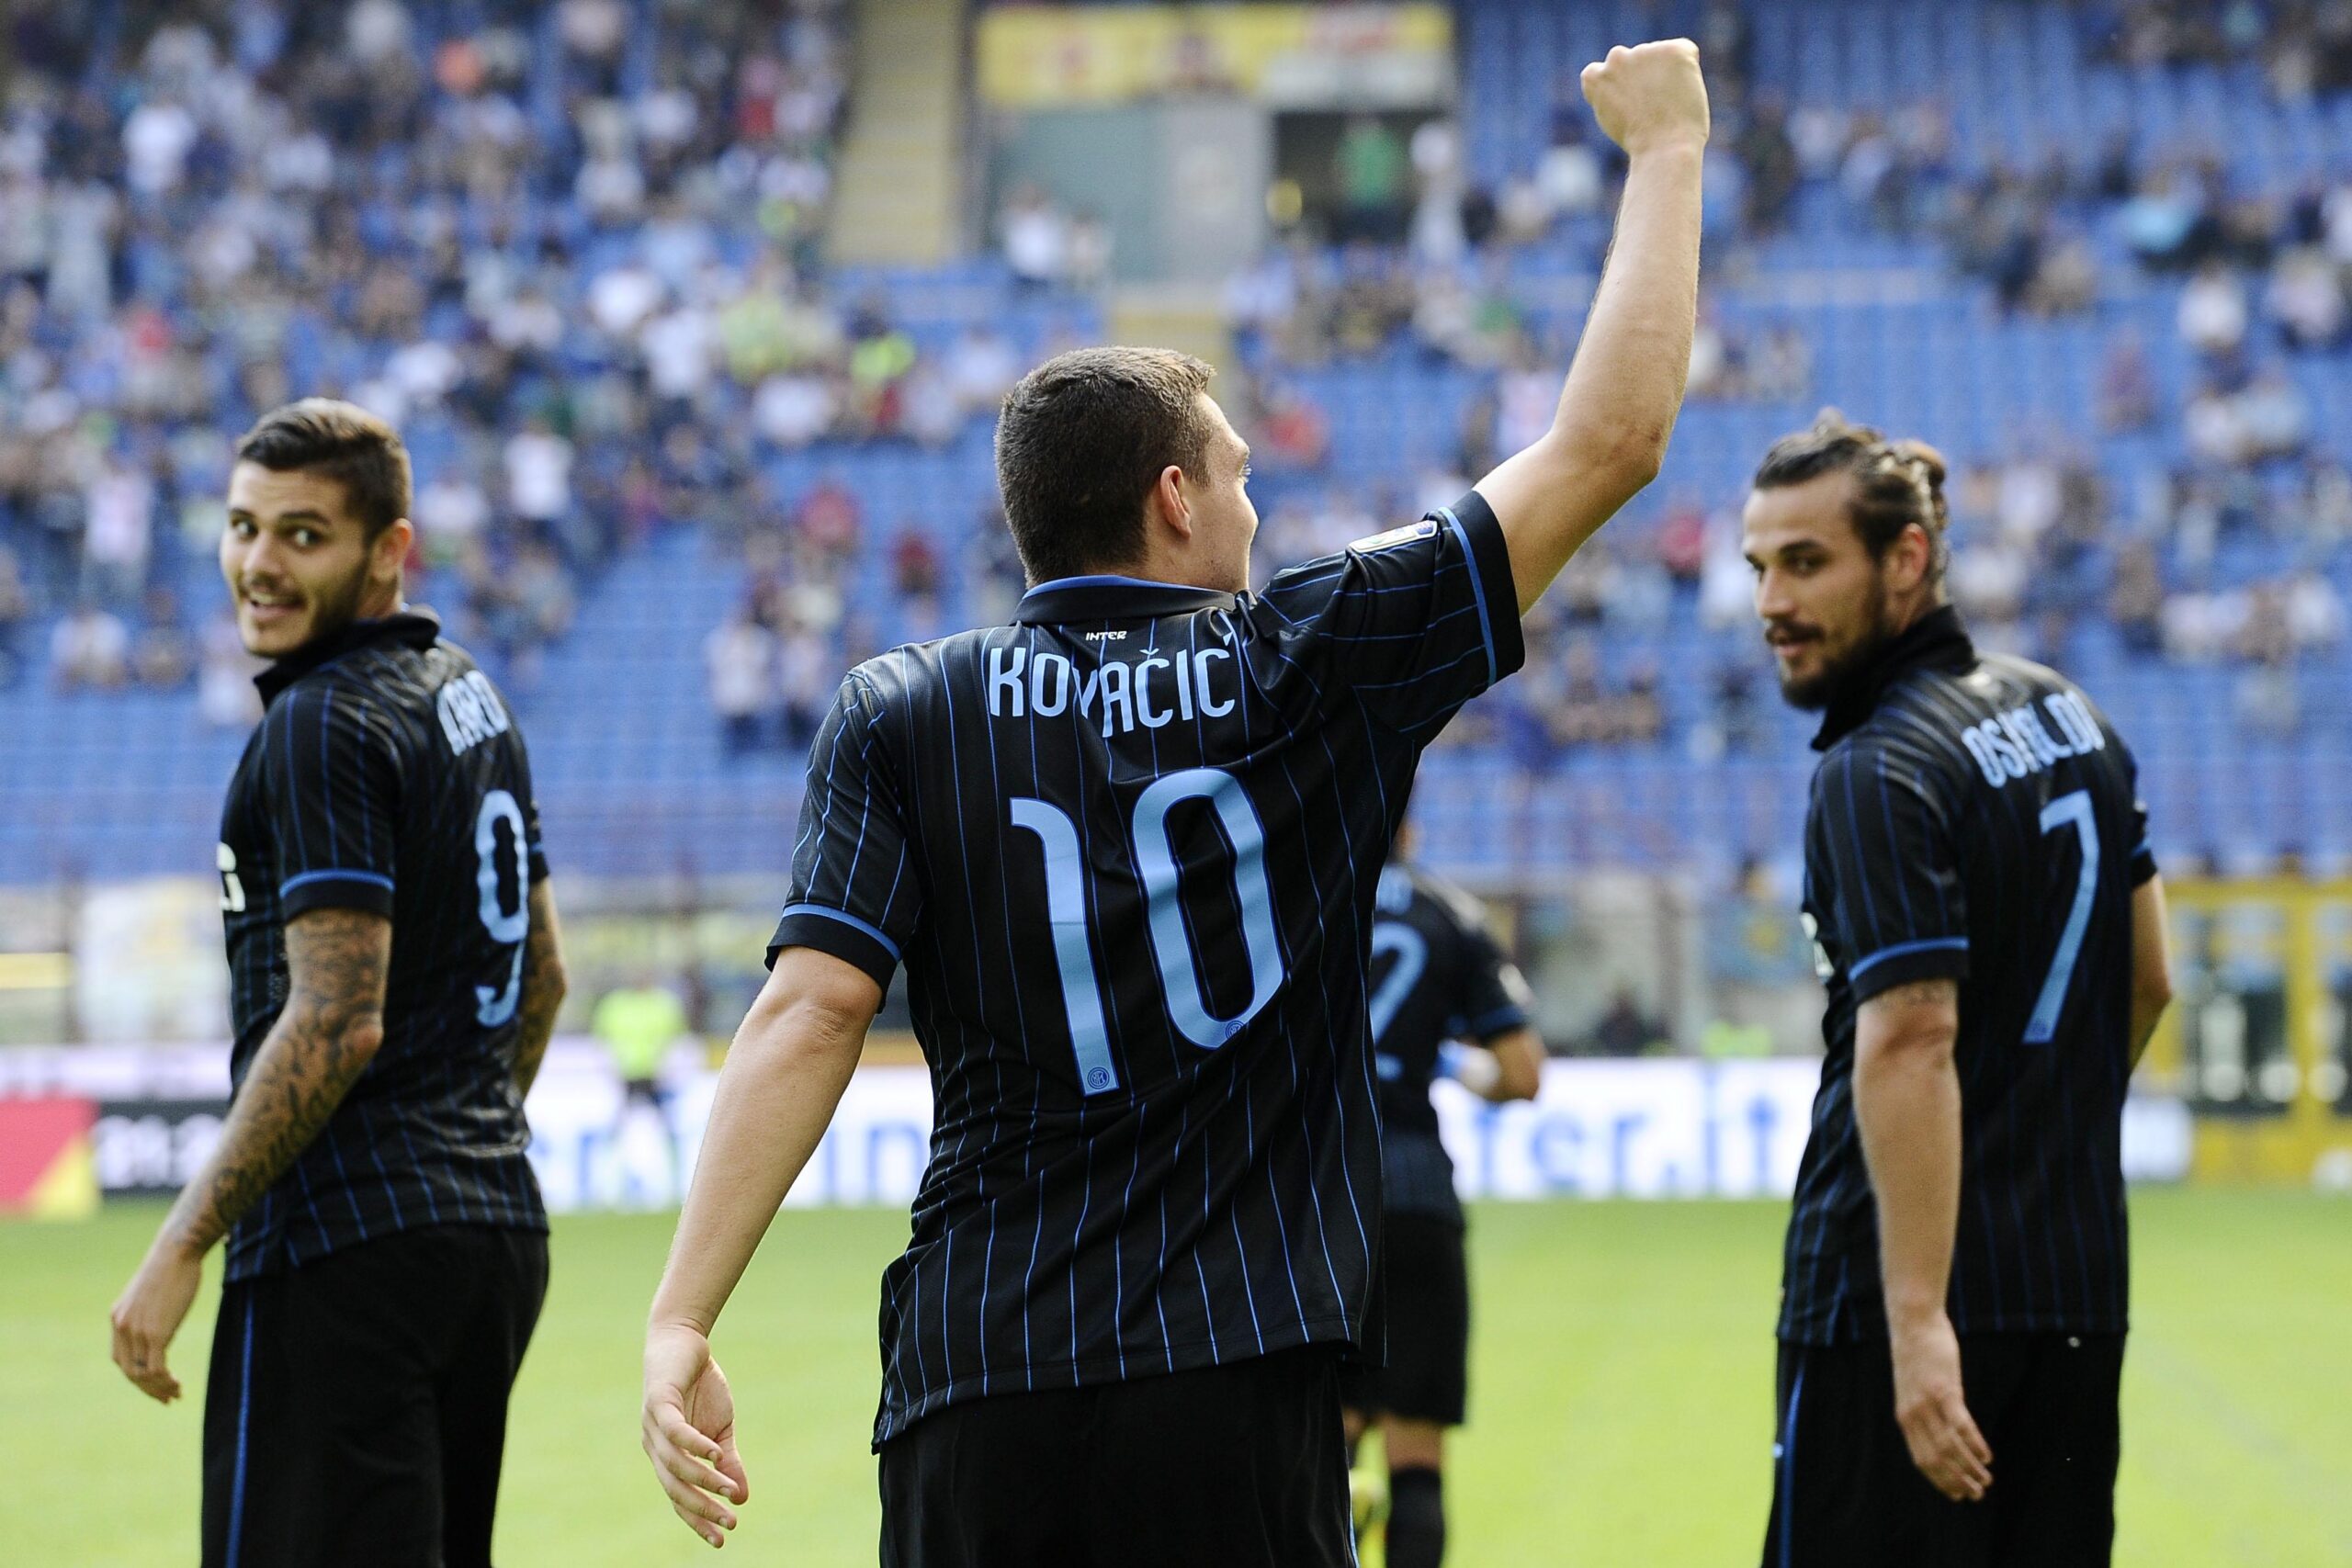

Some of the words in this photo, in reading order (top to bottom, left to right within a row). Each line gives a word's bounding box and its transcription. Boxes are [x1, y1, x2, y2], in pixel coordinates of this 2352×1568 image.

[1085, 630, 1127, 641] INTER
[475, 789, 530, 1028] 9
[1010, 767, 1285, 1098] 10
[2022, 788, 2101, 1044] 7
